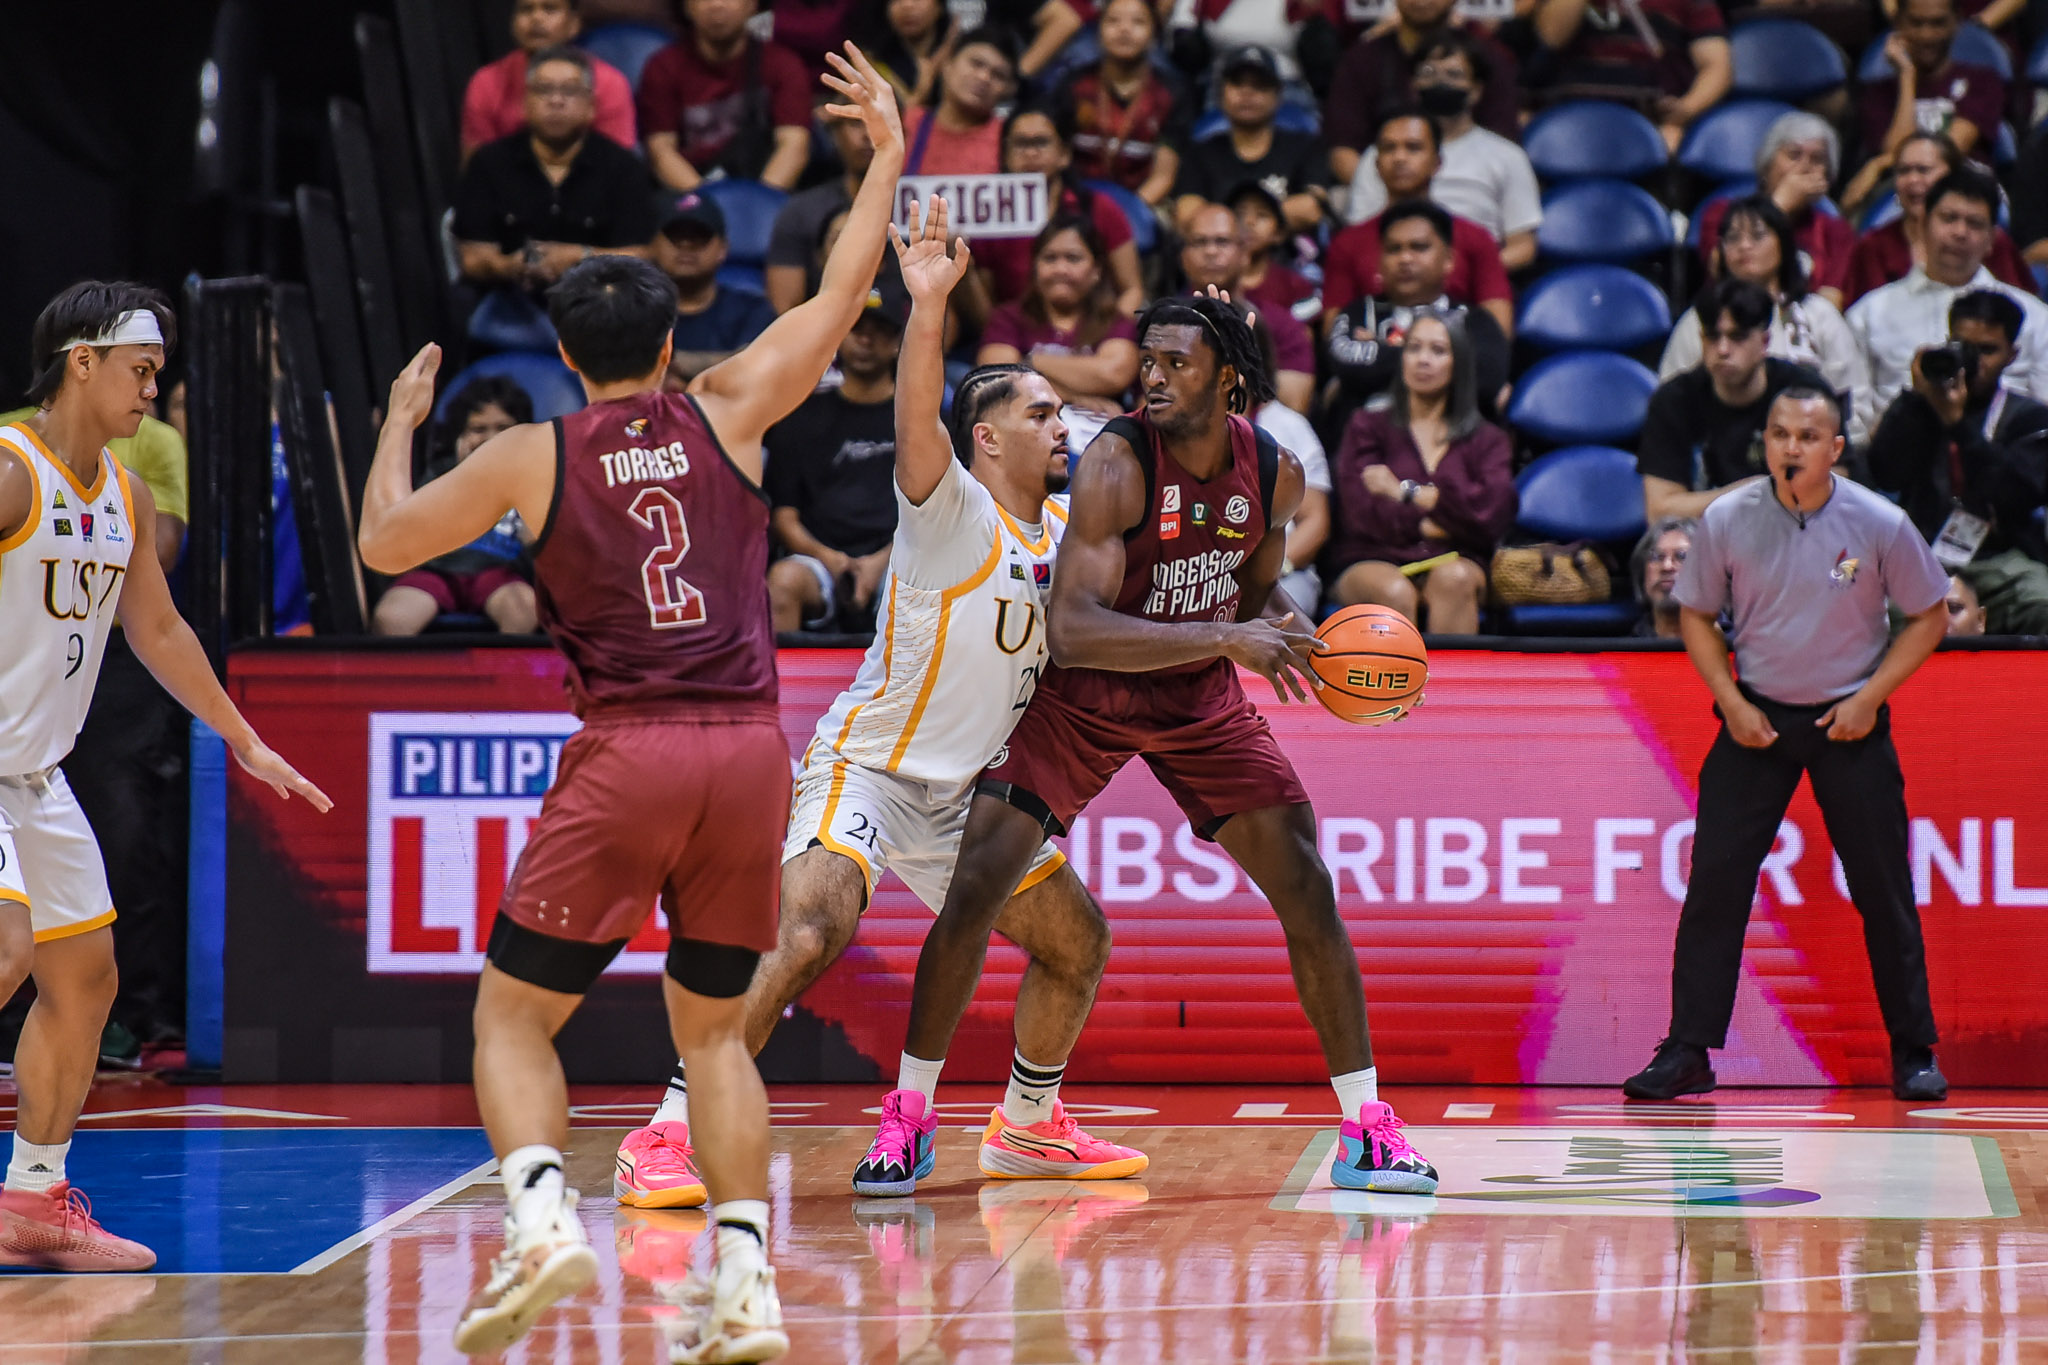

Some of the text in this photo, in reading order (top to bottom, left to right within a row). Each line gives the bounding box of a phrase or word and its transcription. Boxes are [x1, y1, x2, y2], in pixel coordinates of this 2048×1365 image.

[599, 441, 690, 488] TORRES
[1160, 521, 1177, 532] BPI
[627, 486, 707, 630] 2
[40, 558, 126, 621] UST
[64, 633, 84, 680] 9
[1346, 668, 1410, 690] ELITE
[845, 812, 878, 852] 21
